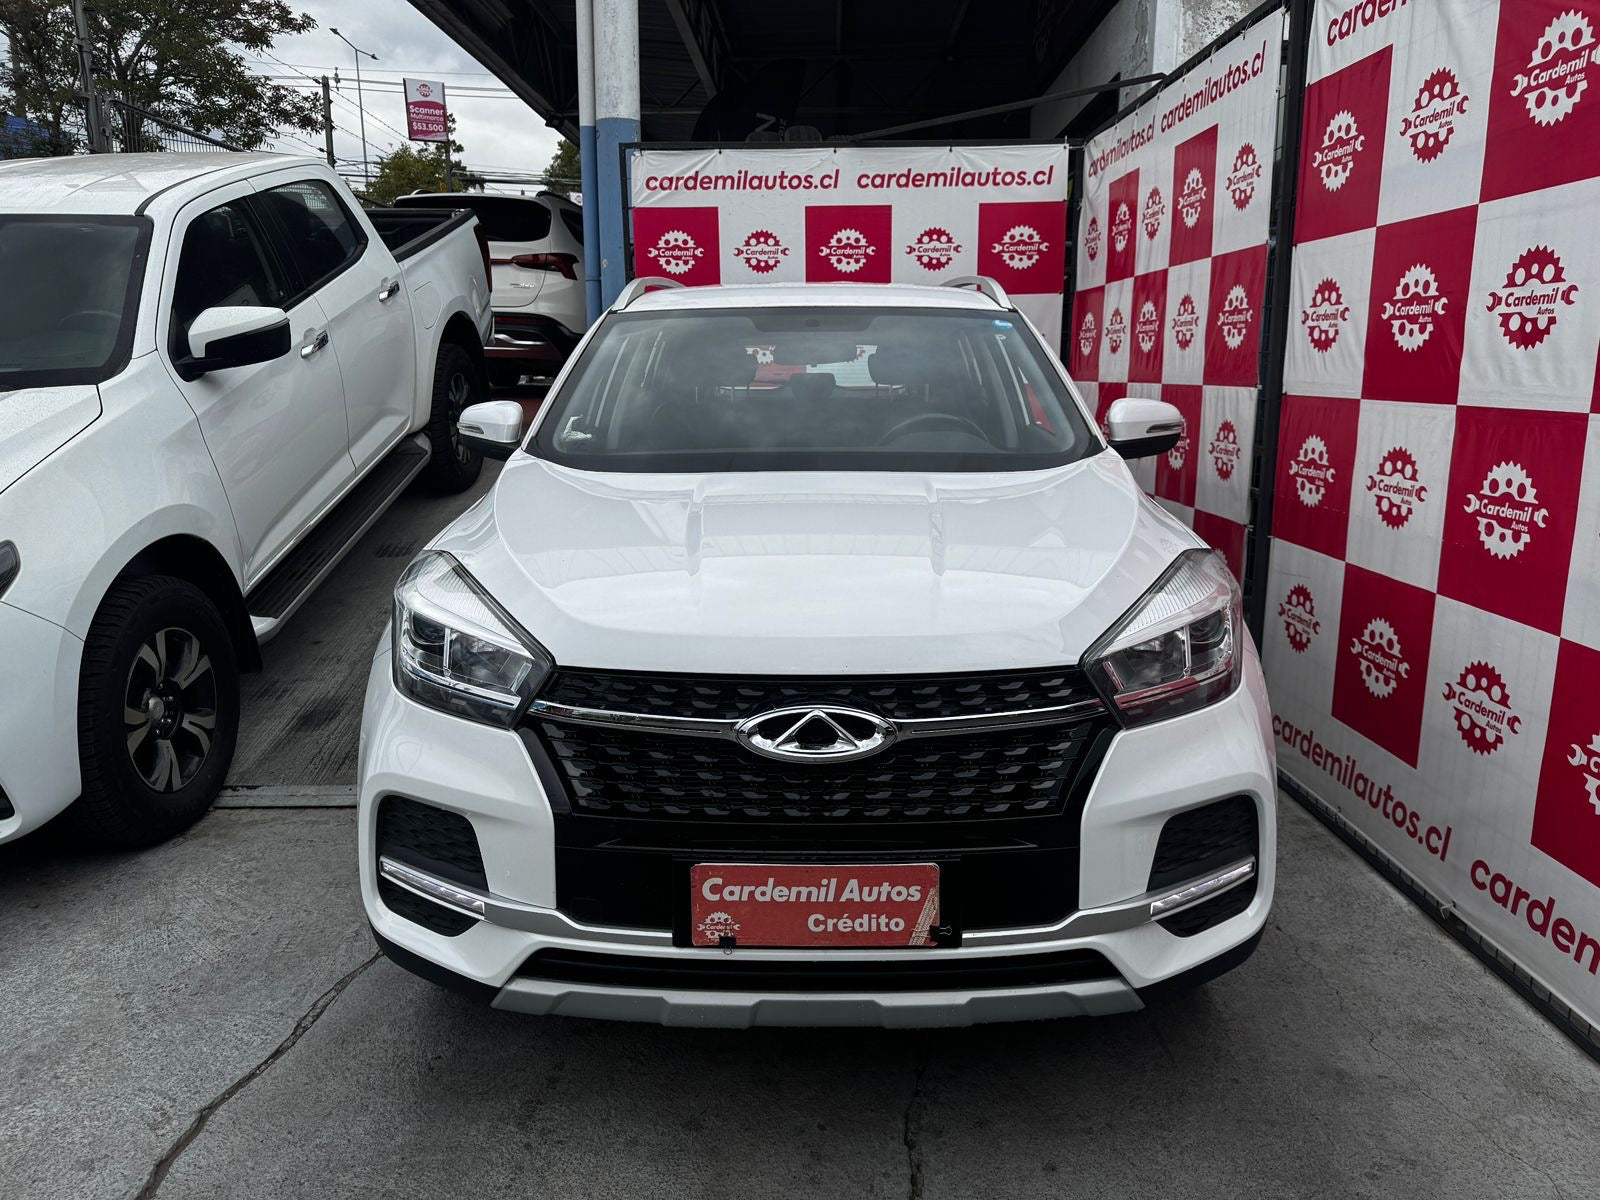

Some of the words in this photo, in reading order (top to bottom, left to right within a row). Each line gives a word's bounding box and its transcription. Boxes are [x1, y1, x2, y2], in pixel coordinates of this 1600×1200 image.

[1529, 49, 1590, 87] Cardemil
[1160, 40, 1267, 133] cardemilautos.cl
[1565, 72, 1585, 85] Autos
[410, 105, 444, 116] Scanner
[410, 113, 444, 121] Multimarca
[1413, 102, 1455, 129] Cardemil
[412, 121, 444, 132] $53.500
[1437, 119, 1453, 130] Autos
[1323, 139, 1355, 161] Cardemil
[645, 169, 840, 191] cardemilautos.cl
[856, 165, 1054, 189] cardemilautos.cl
[660, 248, 694, 256] Cardemil
[746, 247, 779, 256] Cardemil
[831, 246, 866, 255] Cardemil
[1504, 286, 1560, 308] Cardemil
[1311, 308, 1339, 322] Cardemil
[1394, 299, 1434, 317] Cardemil
[1537, 306, 1555, 317] Autos
[1299, 463, 1327, 479] Cardemil
[1377, 479, 1415, 498] Cardemil
[1480, 499, 1534, 522] Cardemil
[1510, 520, 1529, 533] Autos
[1362, 645, 1399, 672] Cardemil
[1457, 691, 1506, 726] Cardemil
[1485, 719, 1502, 734] Autos
[1272, 713, 1452, 862] cardemilautos.cl
[701, 877, 838, 903] Cardemil
[839, 879, 922, 903] Autos
[807, 912, 905, 932] Crédito
